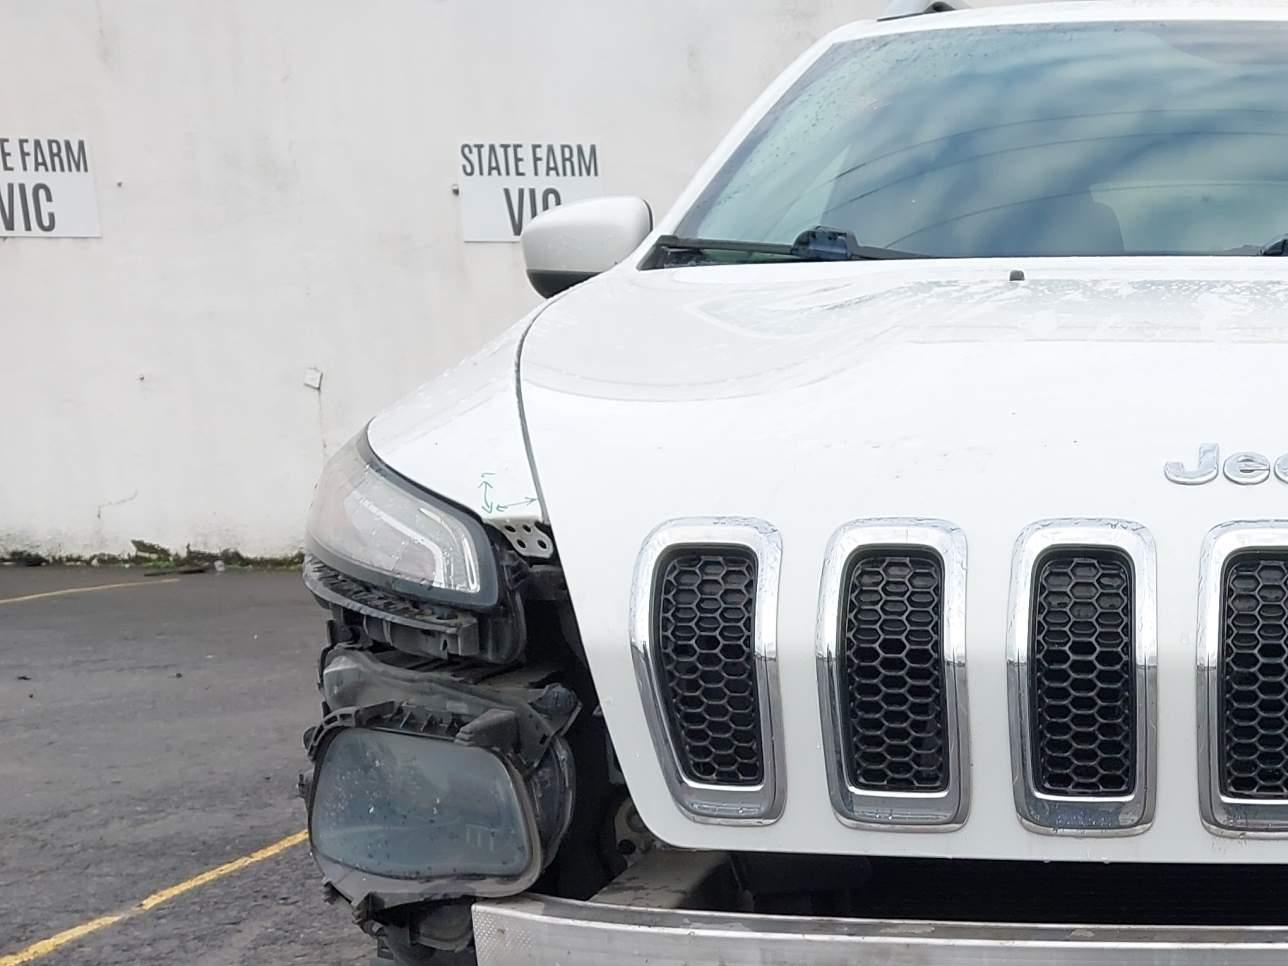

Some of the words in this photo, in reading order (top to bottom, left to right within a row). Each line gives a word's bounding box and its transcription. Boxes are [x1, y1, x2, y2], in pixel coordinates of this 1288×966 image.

[18, 138, 88, 173] FARM
[461, 143, 526, 177] STATE
[531, 143, 599, 177] FARM
